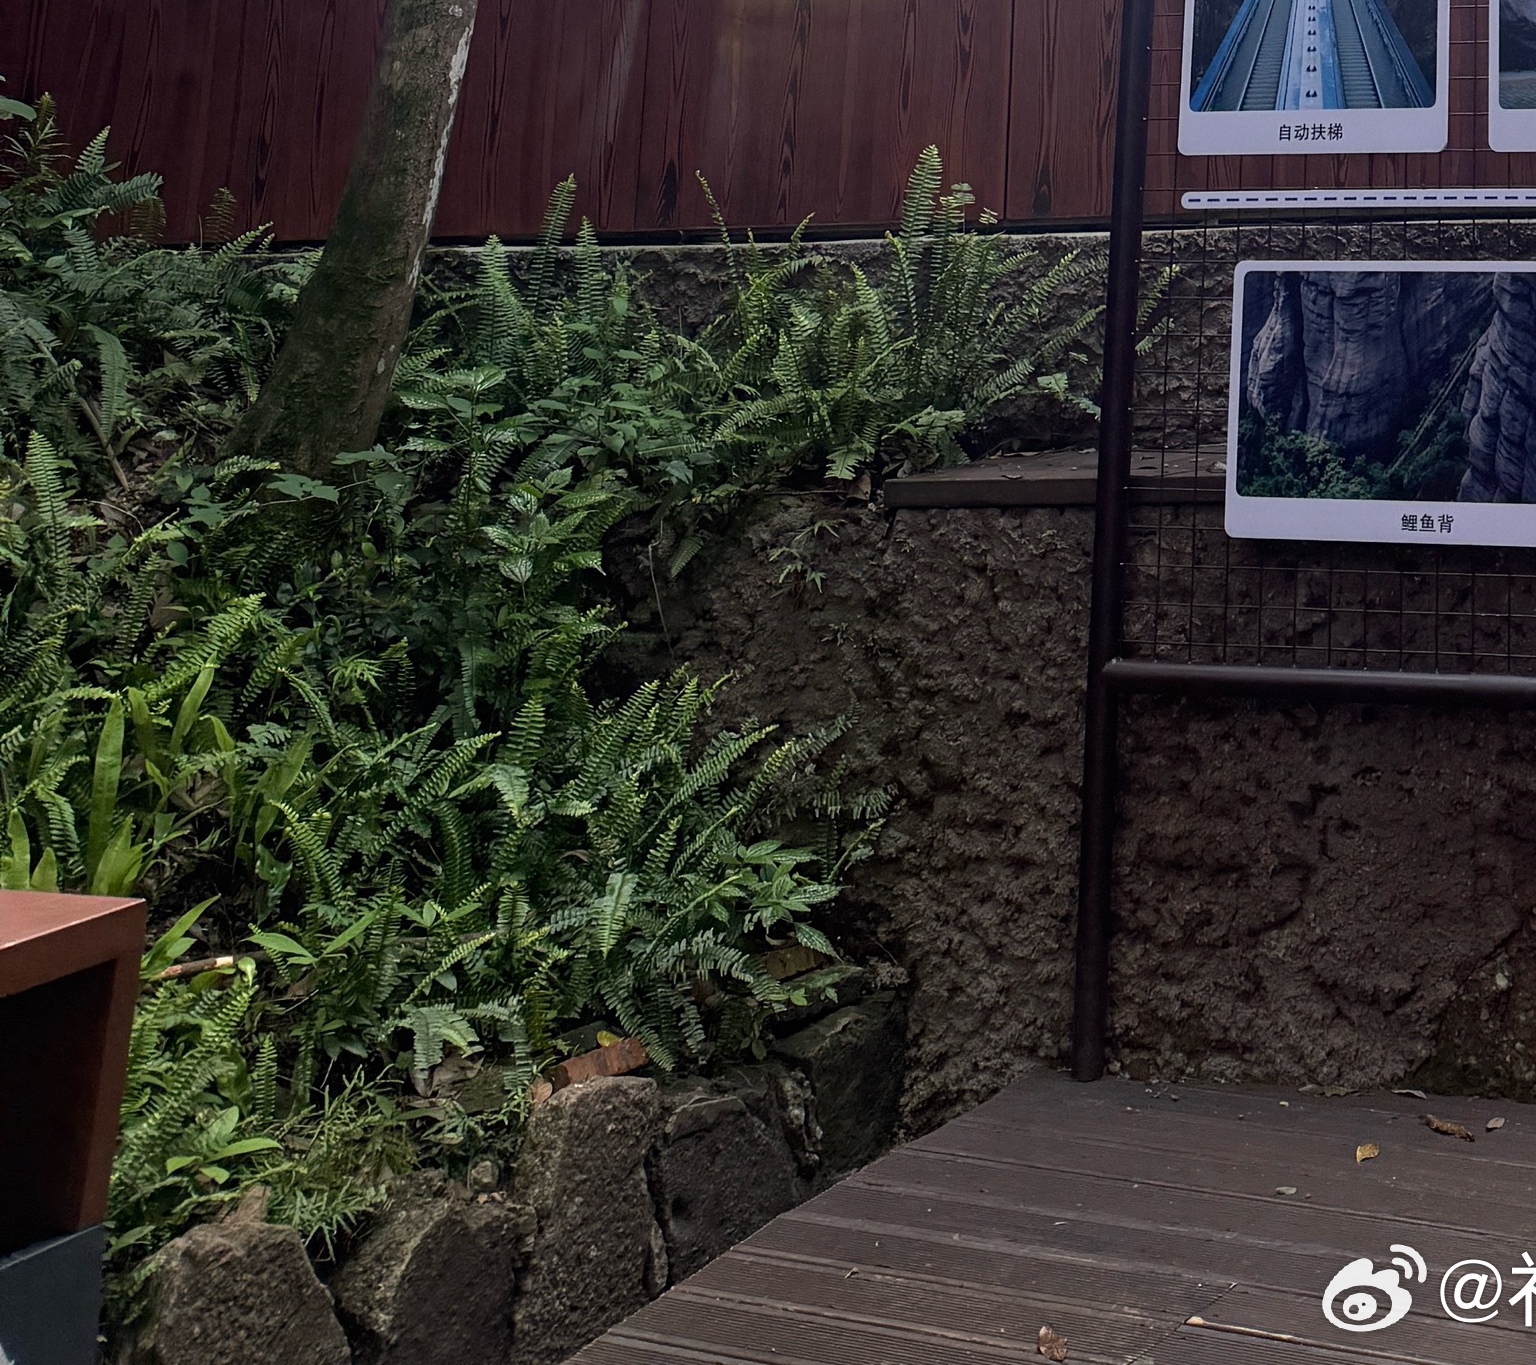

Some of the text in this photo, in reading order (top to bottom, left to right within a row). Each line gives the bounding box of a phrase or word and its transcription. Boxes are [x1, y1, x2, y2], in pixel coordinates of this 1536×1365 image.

[1279, 122, 1343, 141] 自动扶梯
[1401, 513, 1454, 534] 鲤鱼背
